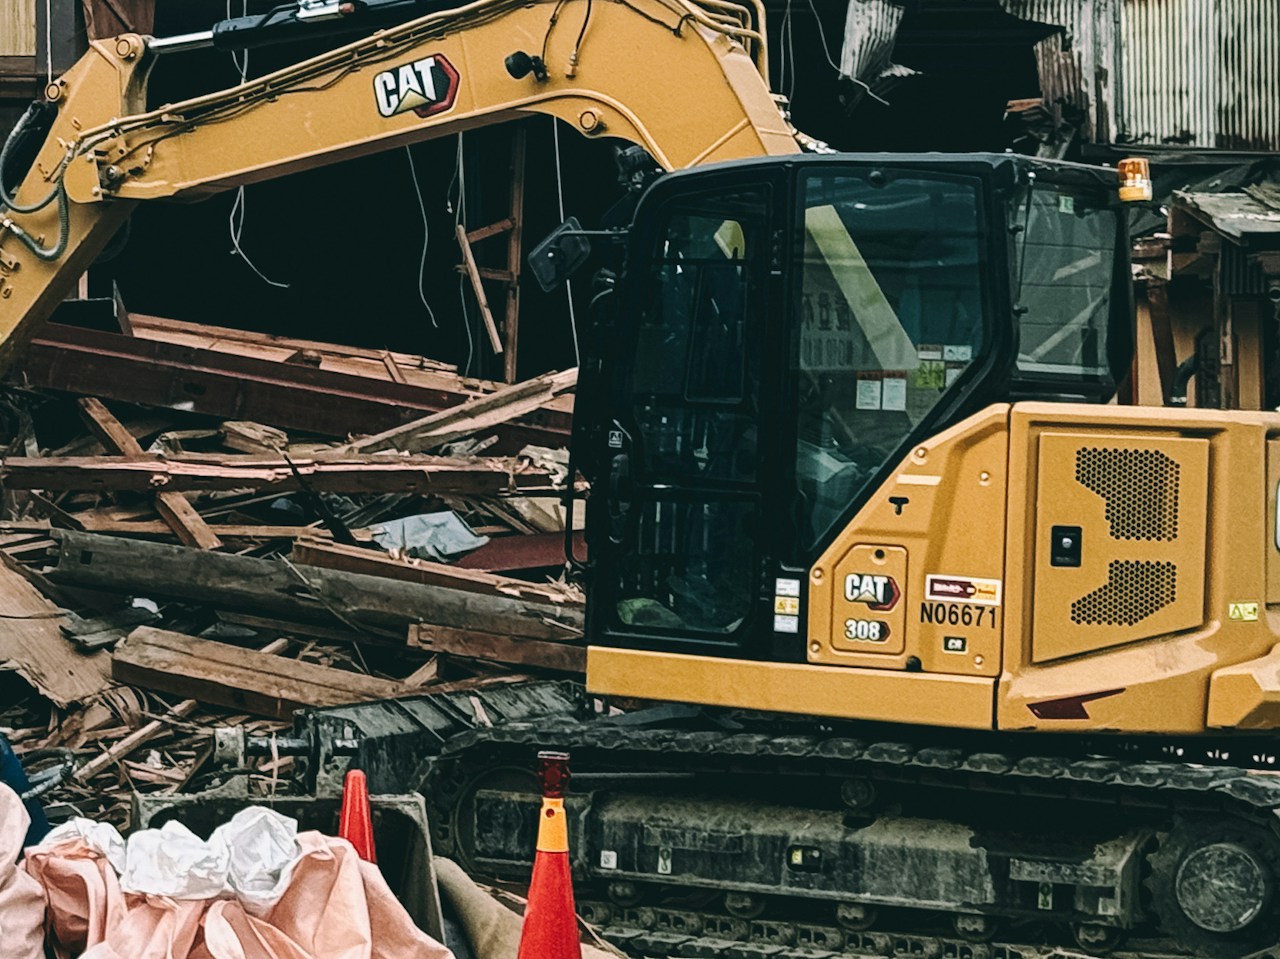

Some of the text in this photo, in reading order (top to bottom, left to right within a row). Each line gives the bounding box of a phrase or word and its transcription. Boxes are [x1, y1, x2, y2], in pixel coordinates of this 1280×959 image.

[374, 57, 437, 116] CAT
[845, 573, 888, 603] CAT
[845, 619, 881, 641] 308
